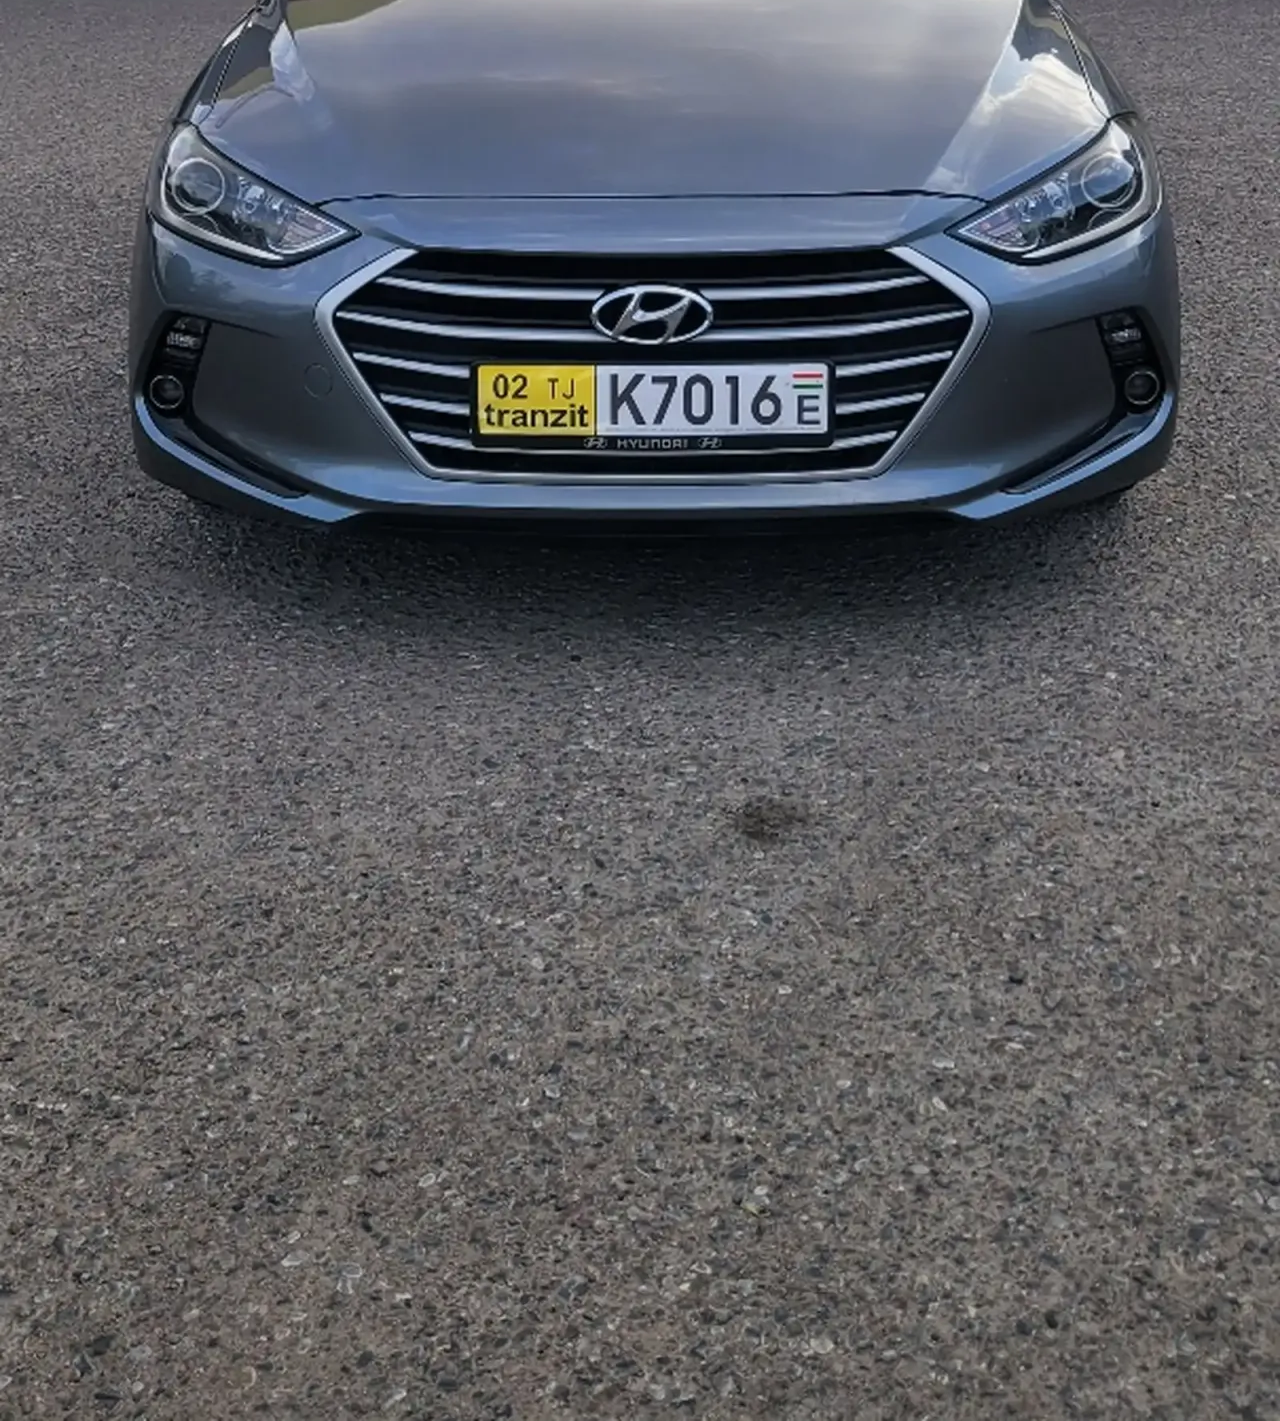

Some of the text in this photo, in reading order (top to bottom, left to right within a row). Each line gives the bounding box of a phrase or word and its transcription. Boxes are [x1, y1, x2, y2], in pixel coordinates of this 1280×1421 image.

[492, 374, 576, 399] 02 TJ
[609, 373, 821, 426] K7016 E
[484, 403, 589, 428] tranzit
[616, 438, 689, 450] HYUNDAI
